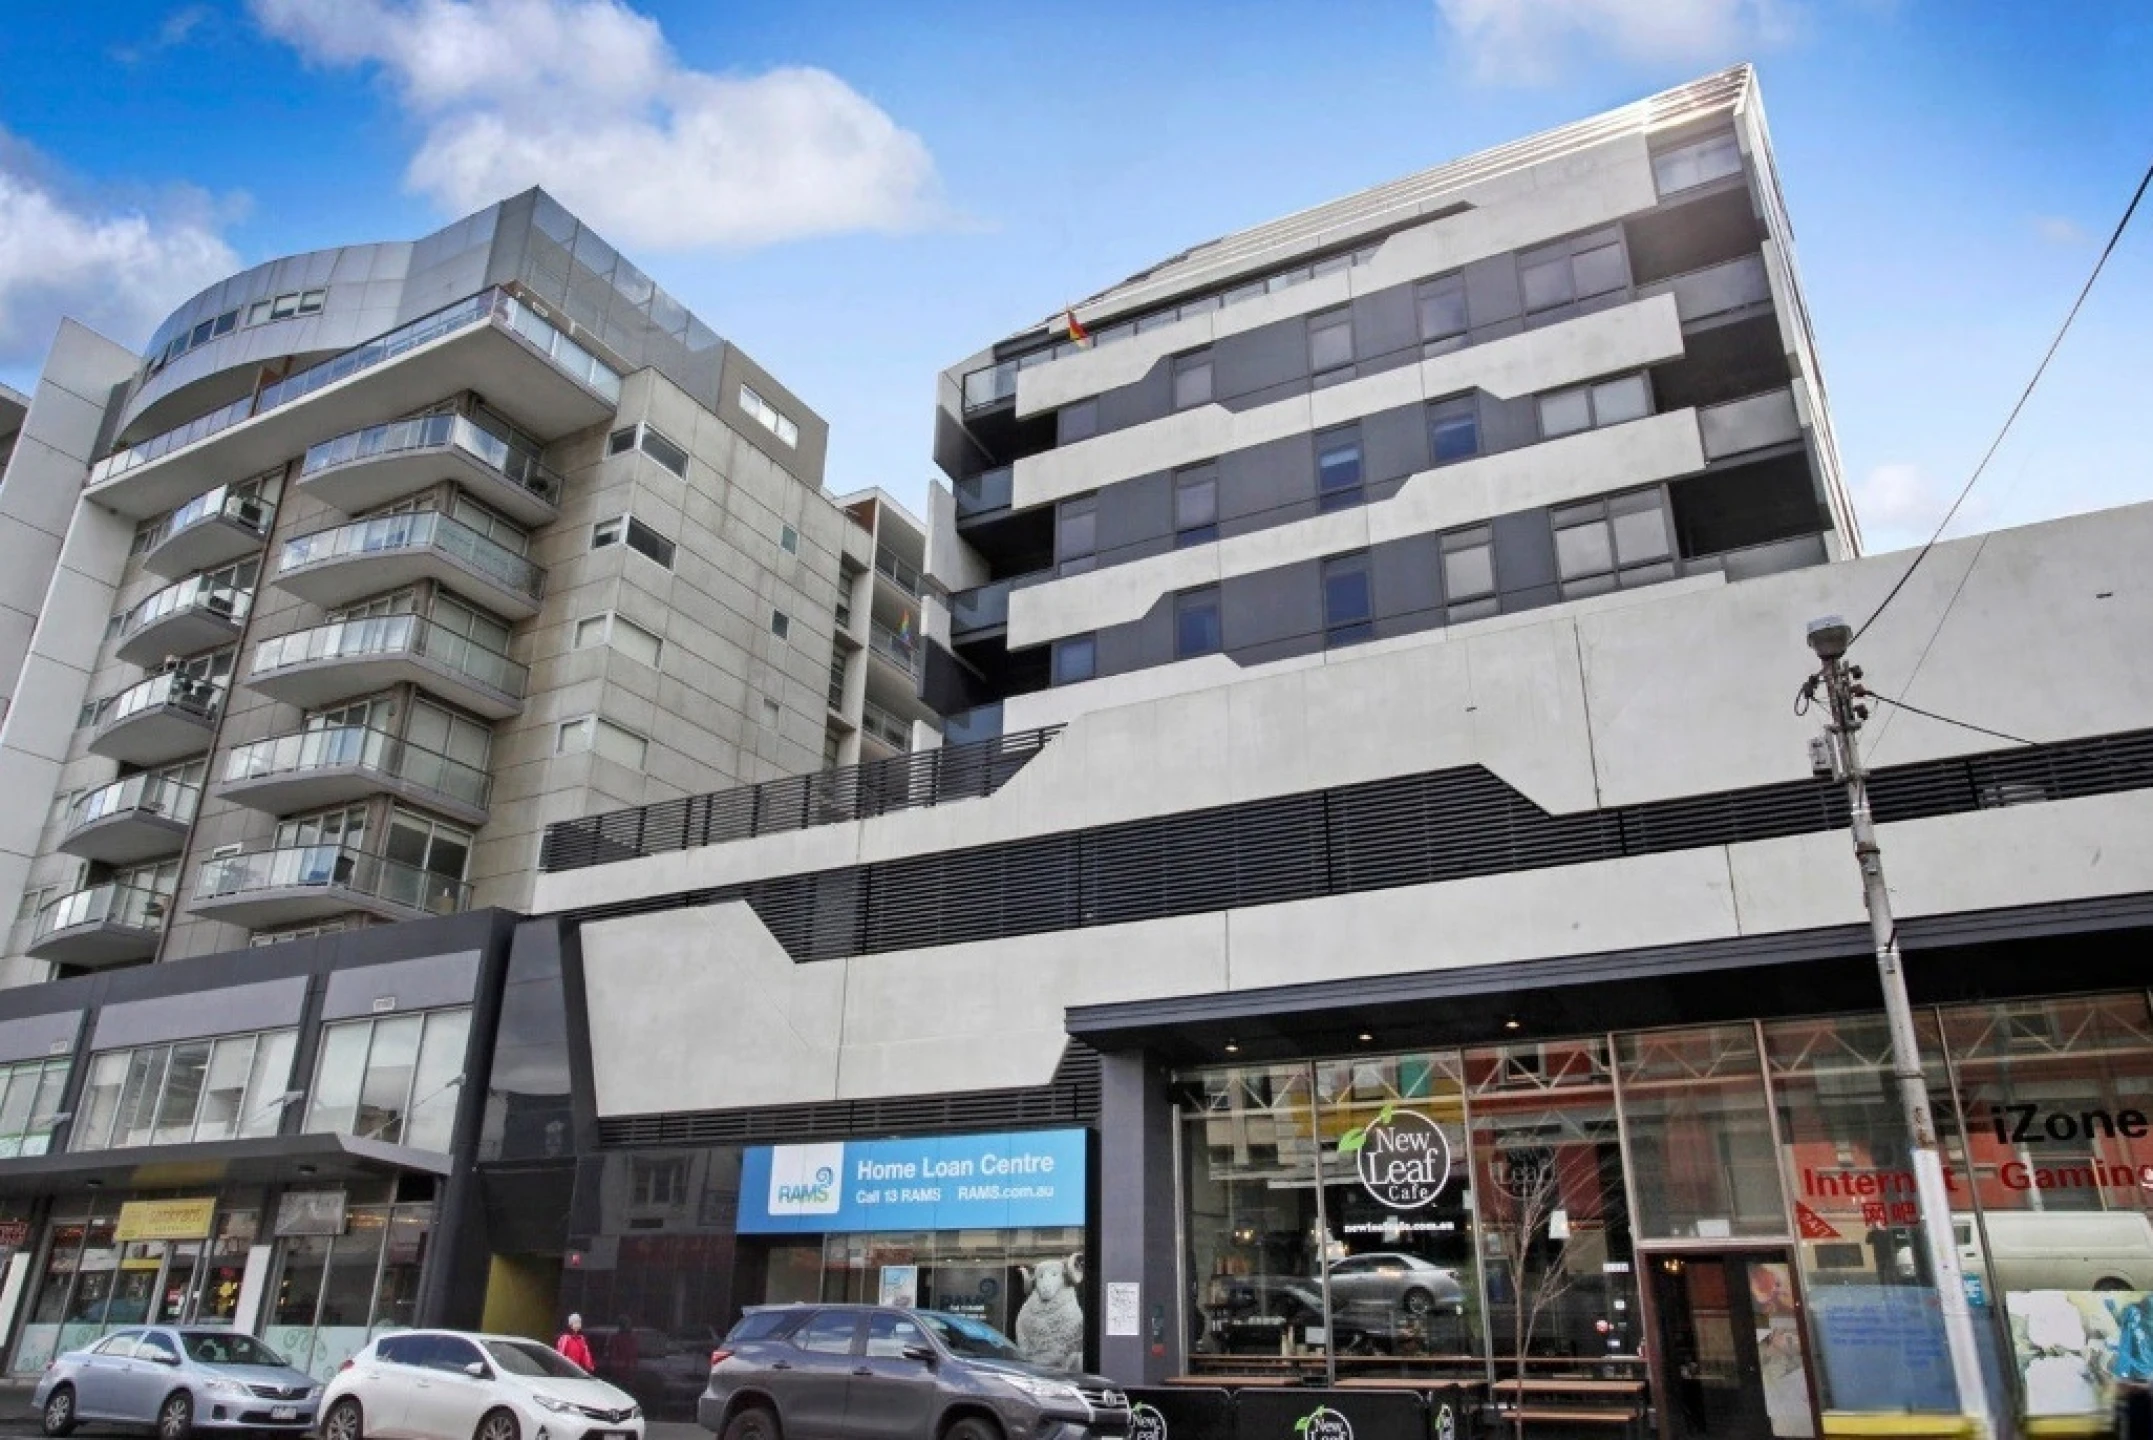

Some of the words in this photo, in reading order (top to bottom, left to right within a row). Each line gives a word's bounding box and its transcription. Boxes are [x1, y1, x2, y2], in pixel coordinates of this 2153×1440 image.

[1991, 1104, 2148, 1144] iZone
[1375, 1127, 1430, 1152] New
[857, 1160, 916, 1181] Home
[922, 1157, 974, 1178] Loan
[980, 1153, 1055, 1175] Centre
[1366, 1148, 1439, 1185] Leaf
[778, 1184, 830, 1204] RAMS
[856, 1189, 880, 1204] Call
[885, 1188, 898, 1203] 13
[902, 1187, 942, 1203] RAMS
[958, 1185, 1055, 1201] RAMS.com.au
[1388, 1182, 1428, 1200] Cafe
[1804, 1167, 1959, 1197] Internt
[1315, 1418, 1342, 1432] New
